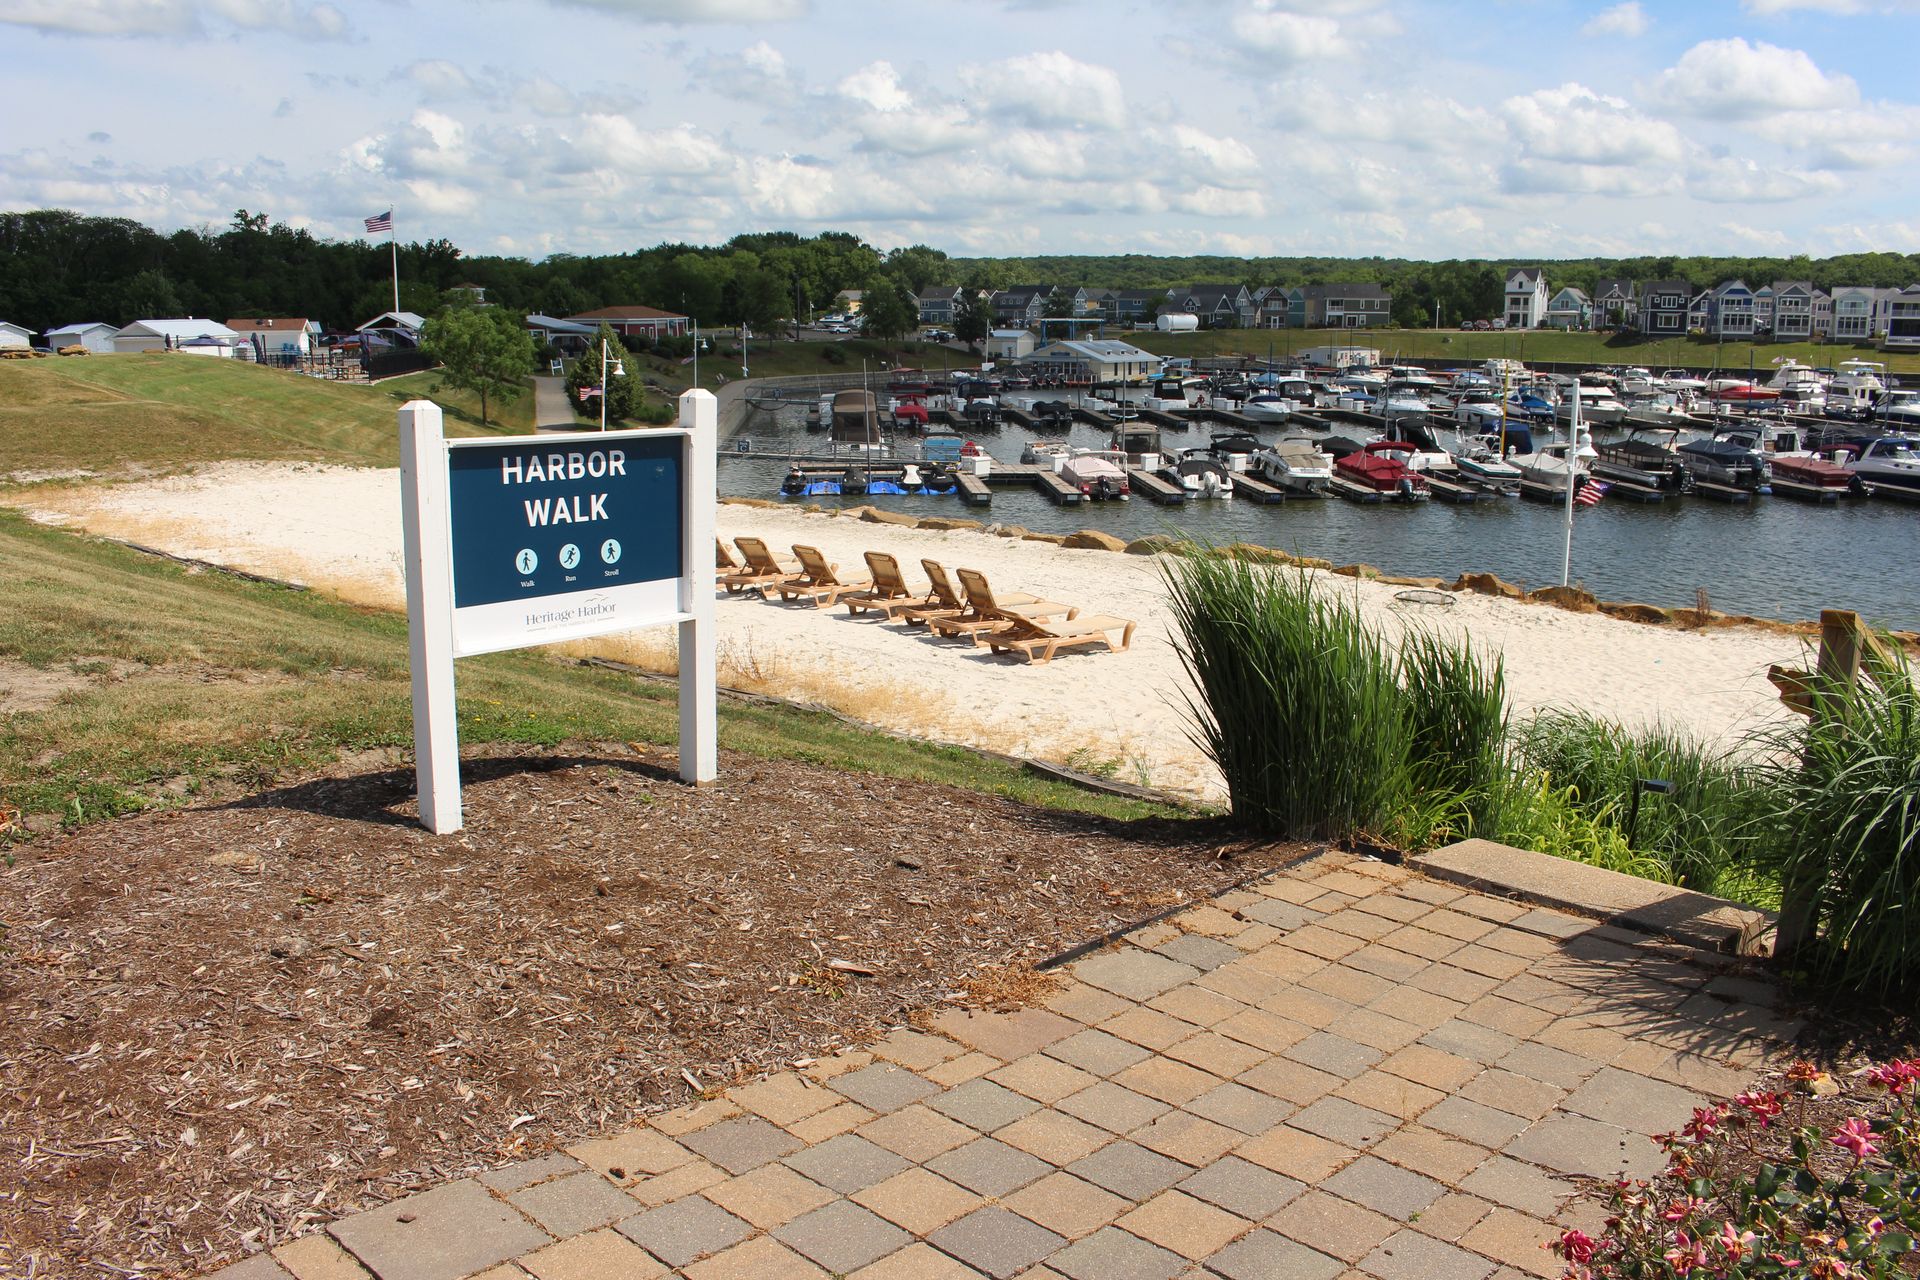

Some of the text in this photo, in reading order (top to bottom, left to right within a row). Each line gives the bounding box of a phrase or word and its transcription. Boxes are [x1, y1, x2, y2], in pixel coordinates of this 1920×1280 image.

[502, 450, 626, 485] HARBOR
[524, 493, 609, 528] WALK
[520, 580, 535, 588] Walk
[604, 569, 619, 577] Stroll
[526, 608, 575, 625] Heritage
[578, 603, 617, 617] Harbor
